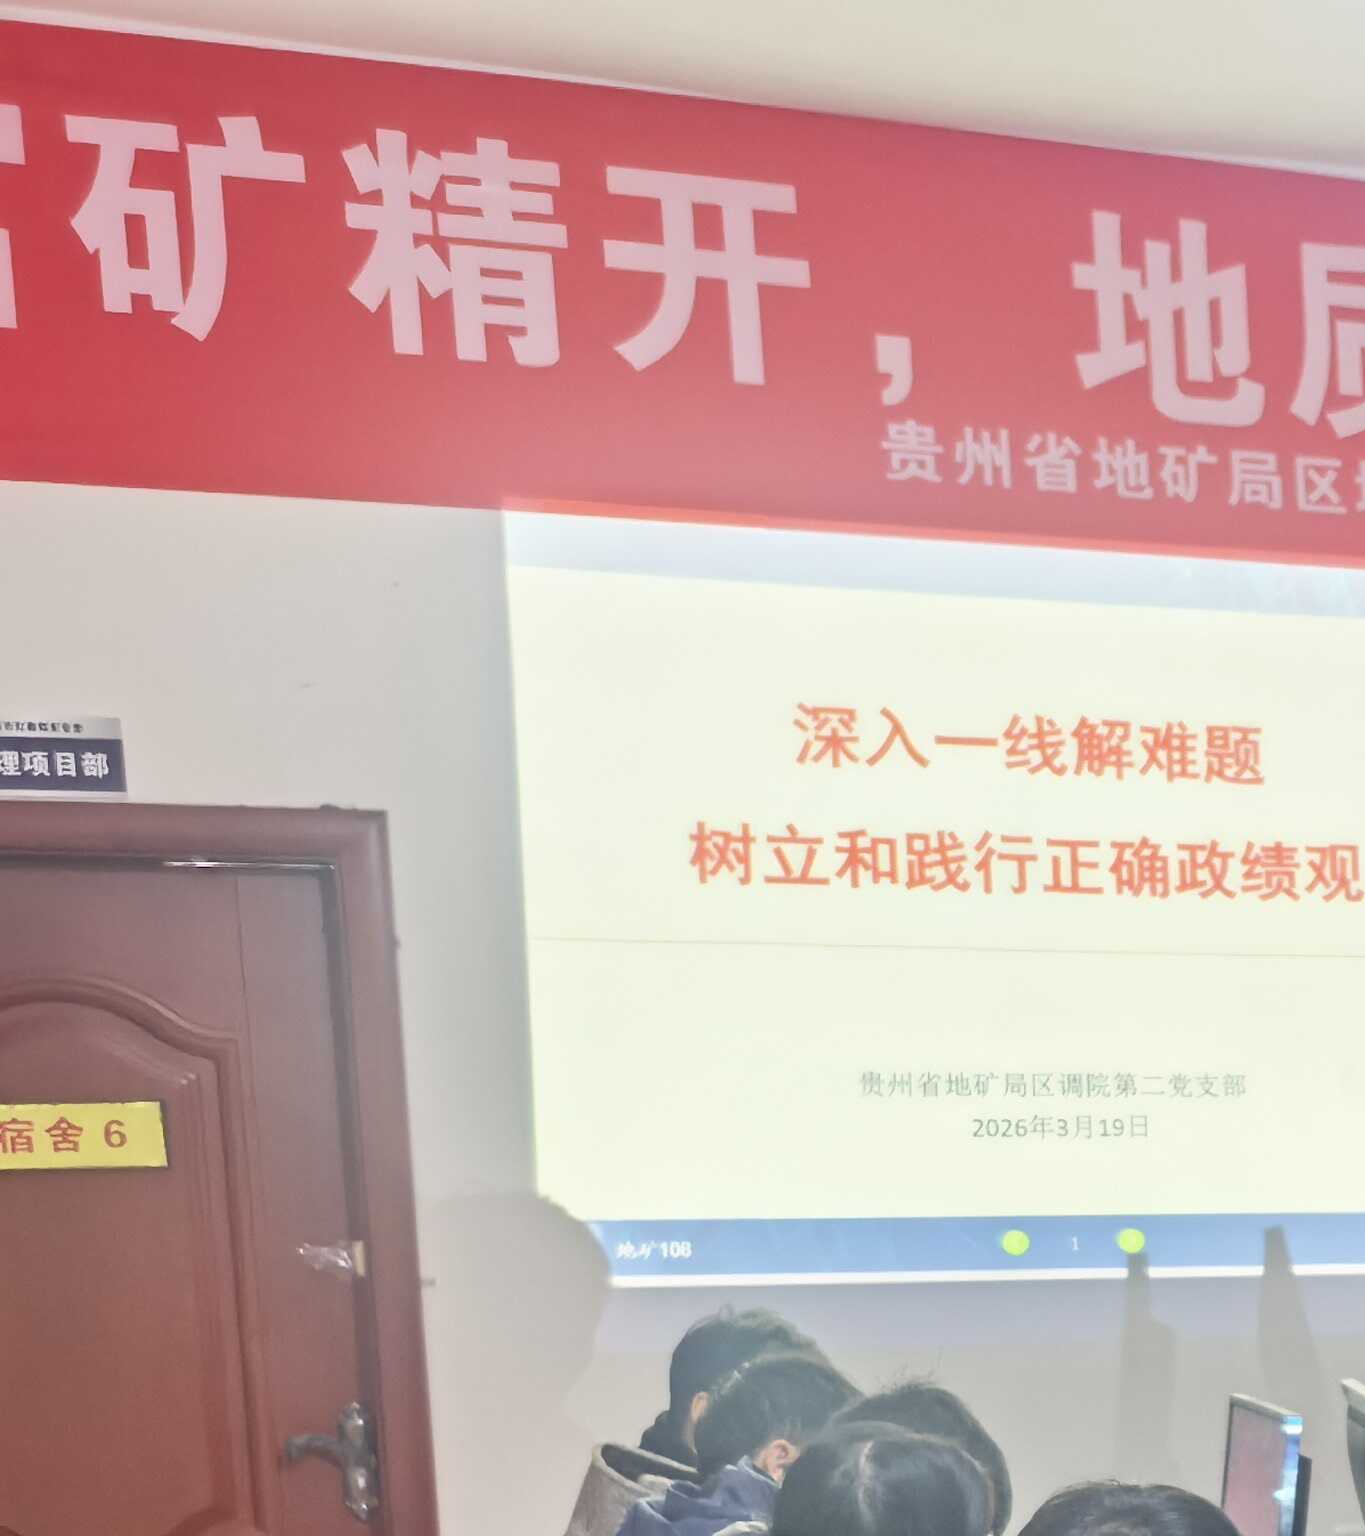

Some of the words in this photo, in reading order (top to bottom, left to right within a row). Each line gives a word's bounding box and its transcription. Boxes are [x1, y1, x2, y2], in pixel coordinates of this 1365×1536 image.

[793, 702, 1265, 786] 深入一线解难题
[690, 821, 1365, 904] 树立和践行正确政绩观
[859, 1070, 1247, 1100] 贵州省地矿局区调院第二党支部
[971, 1113, 1150, 1141] 2026年3月19日
